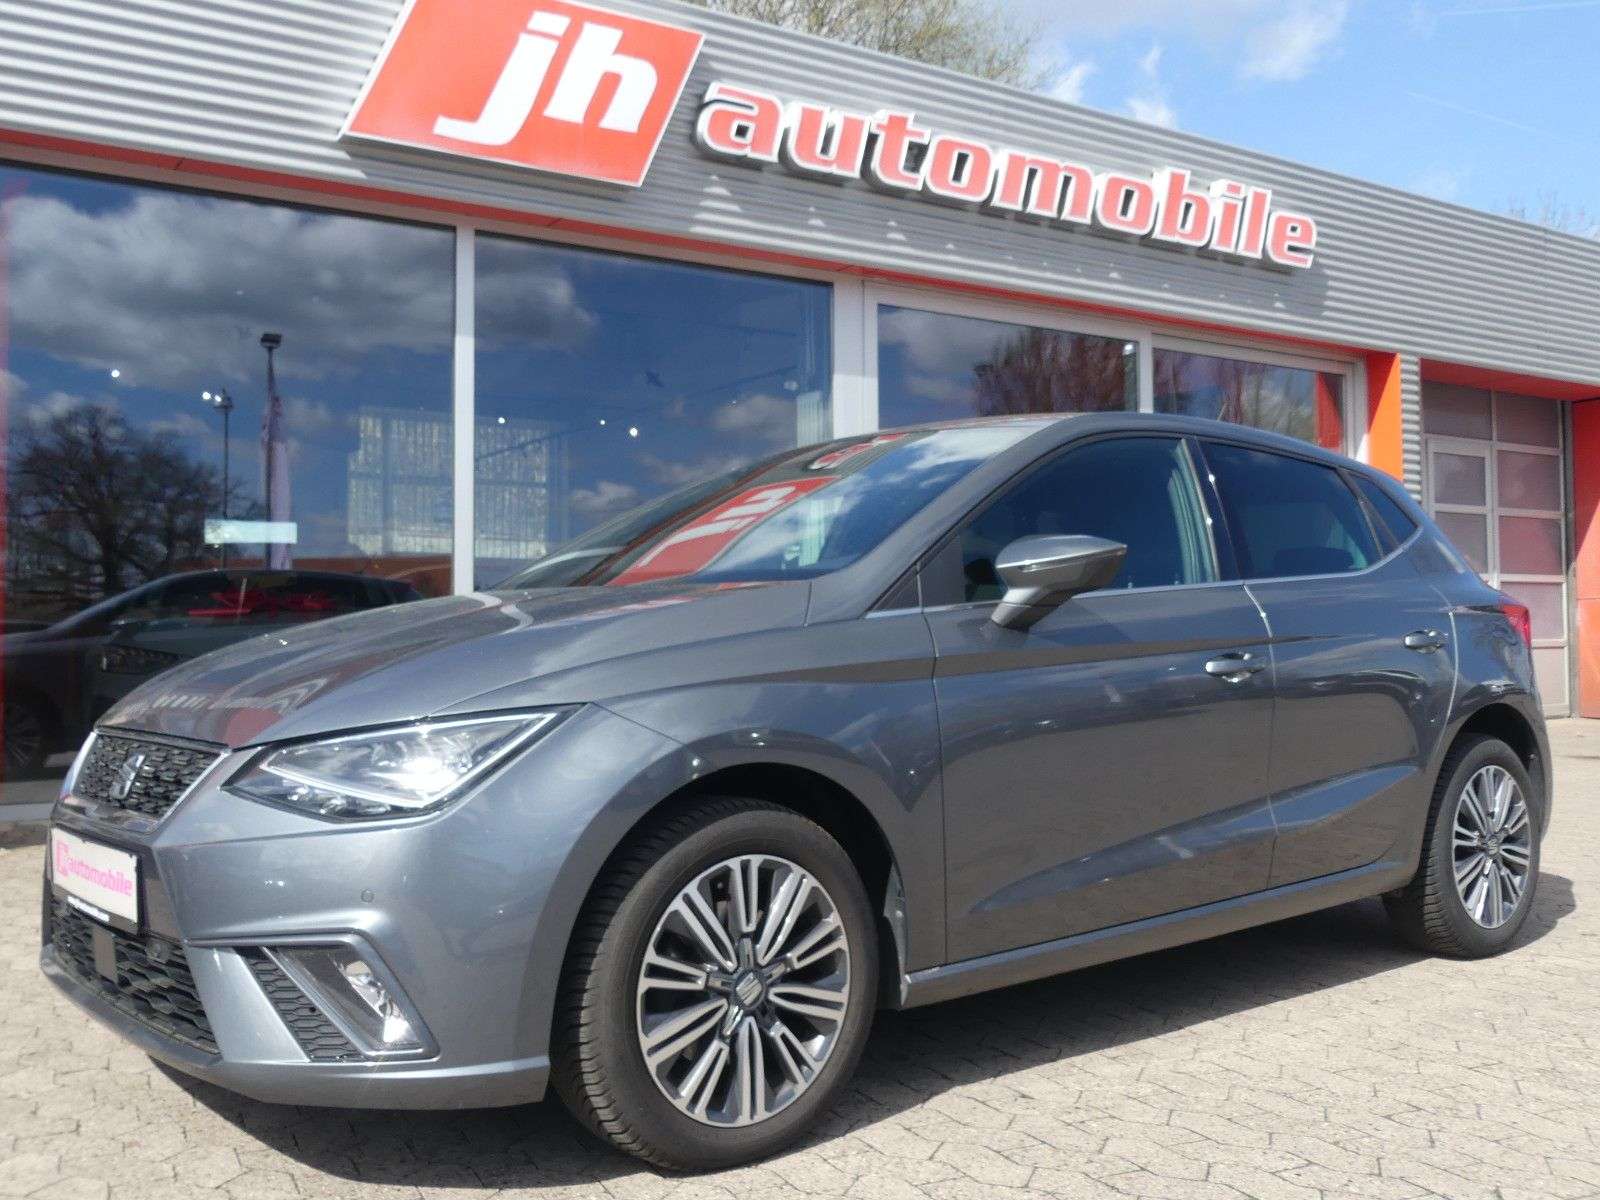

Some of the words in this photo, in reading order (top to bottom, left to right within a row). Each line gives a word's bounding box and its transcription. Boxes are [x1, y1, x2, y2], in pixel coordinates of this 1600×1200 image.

[433, 10, 657, 145] jh
[696, 81, 1317, 269] automobile
[68, 858, 133, 896] automobile
